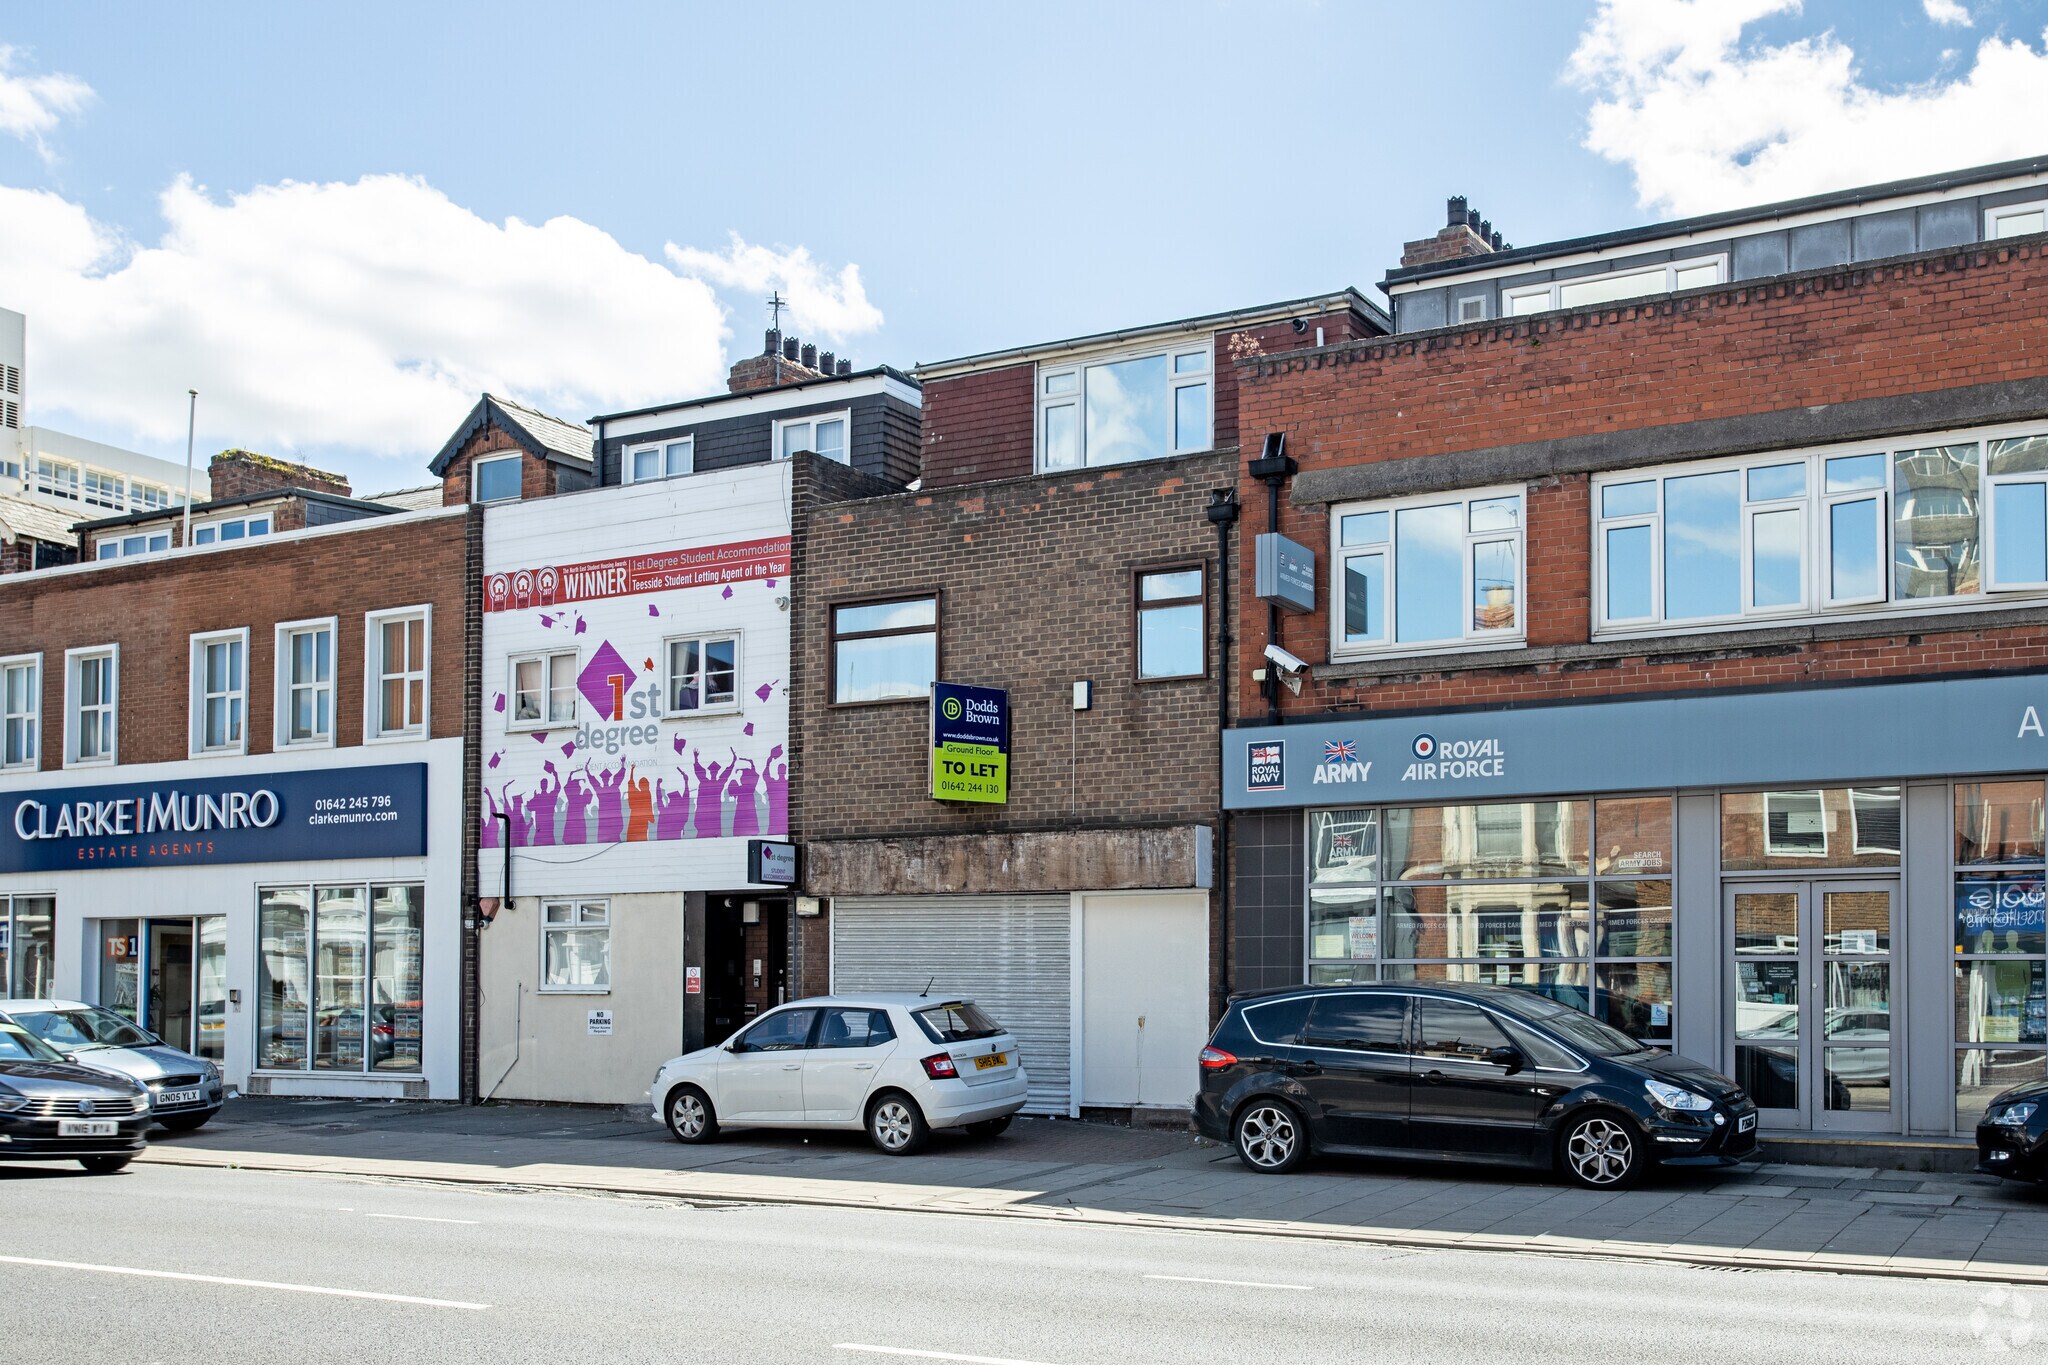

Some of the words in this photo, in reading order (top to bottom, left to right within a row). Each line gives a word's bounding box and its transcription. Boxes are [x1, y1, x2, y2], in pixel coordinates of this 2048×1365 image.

[633, 560, 645, 571] 1st
[647, 556, 678, 570] Degree
[680, 551, 715, 564] Student
[717, 541, 791, 560] Accommodation
[632, 579, 663, 591] Teesside
[665, 574, 692, 586] Student
[694, 570, 719, 583] Letting
[721, 567, 743, 581] Agent
[745, 565, 753, 576] of
[755, 563, 767, 575] the
[769, 561, 785, 574] Year
[564, 568, 627, 599] WINNER
[607, 674, 661, 721] 1st
[966, 699, 998, 713] Dodds
[966, 711, 1000, 725] Brown
[575, 722, 658, 755] degree
[943, 732, 999, 742] www.doddsbrown.co.uk
[947, 745, 974, 754] Ground
[975, 747, 994, 756] Floor
[1439, 739, 1504, 759] ROYAL
[942, 761, 965, 775] TO
[971, 763, 998, 777] LET
[1252, 765, 1280, 774] ROYAL
[1312, 762, 1372, 784] ARMY
[1401, 763, 1437, 781] AIR
[1439, 759, 1504, 779] FORCE
[1252, 773, 1280, 783] NAVY
[941, 781, 965, 791] 01642
[968, 783, 982, 792] 244
[986, 784, 998, 793] 130
[315, 798, 346, 811] 01642
[349, 796, 368, 809] 245
[371, 795, 391, 807] 796
[15, 799, 135, 840] CLARKE
[148, 790, 279, 832] MUNRO
[309, 810, 397, 825] clarkemunro.com
[78, 846, 138, 860] ESTATE
[148, 842, 214, 856] AGENTS
[1329, 847, 1358, 857] ARMY
[1634, 851, 1661, 859] SEARCH
[777, 854, 794, 863] degree
[1620, 860, 1641, 868] ARMY
[1643, 859, 1661, 867] JOBS
[1485, 920, 1507, 928] FORCES
[160, 1093, 180, 1102] GN05
[182, 1091, 197, 1100] YLX
